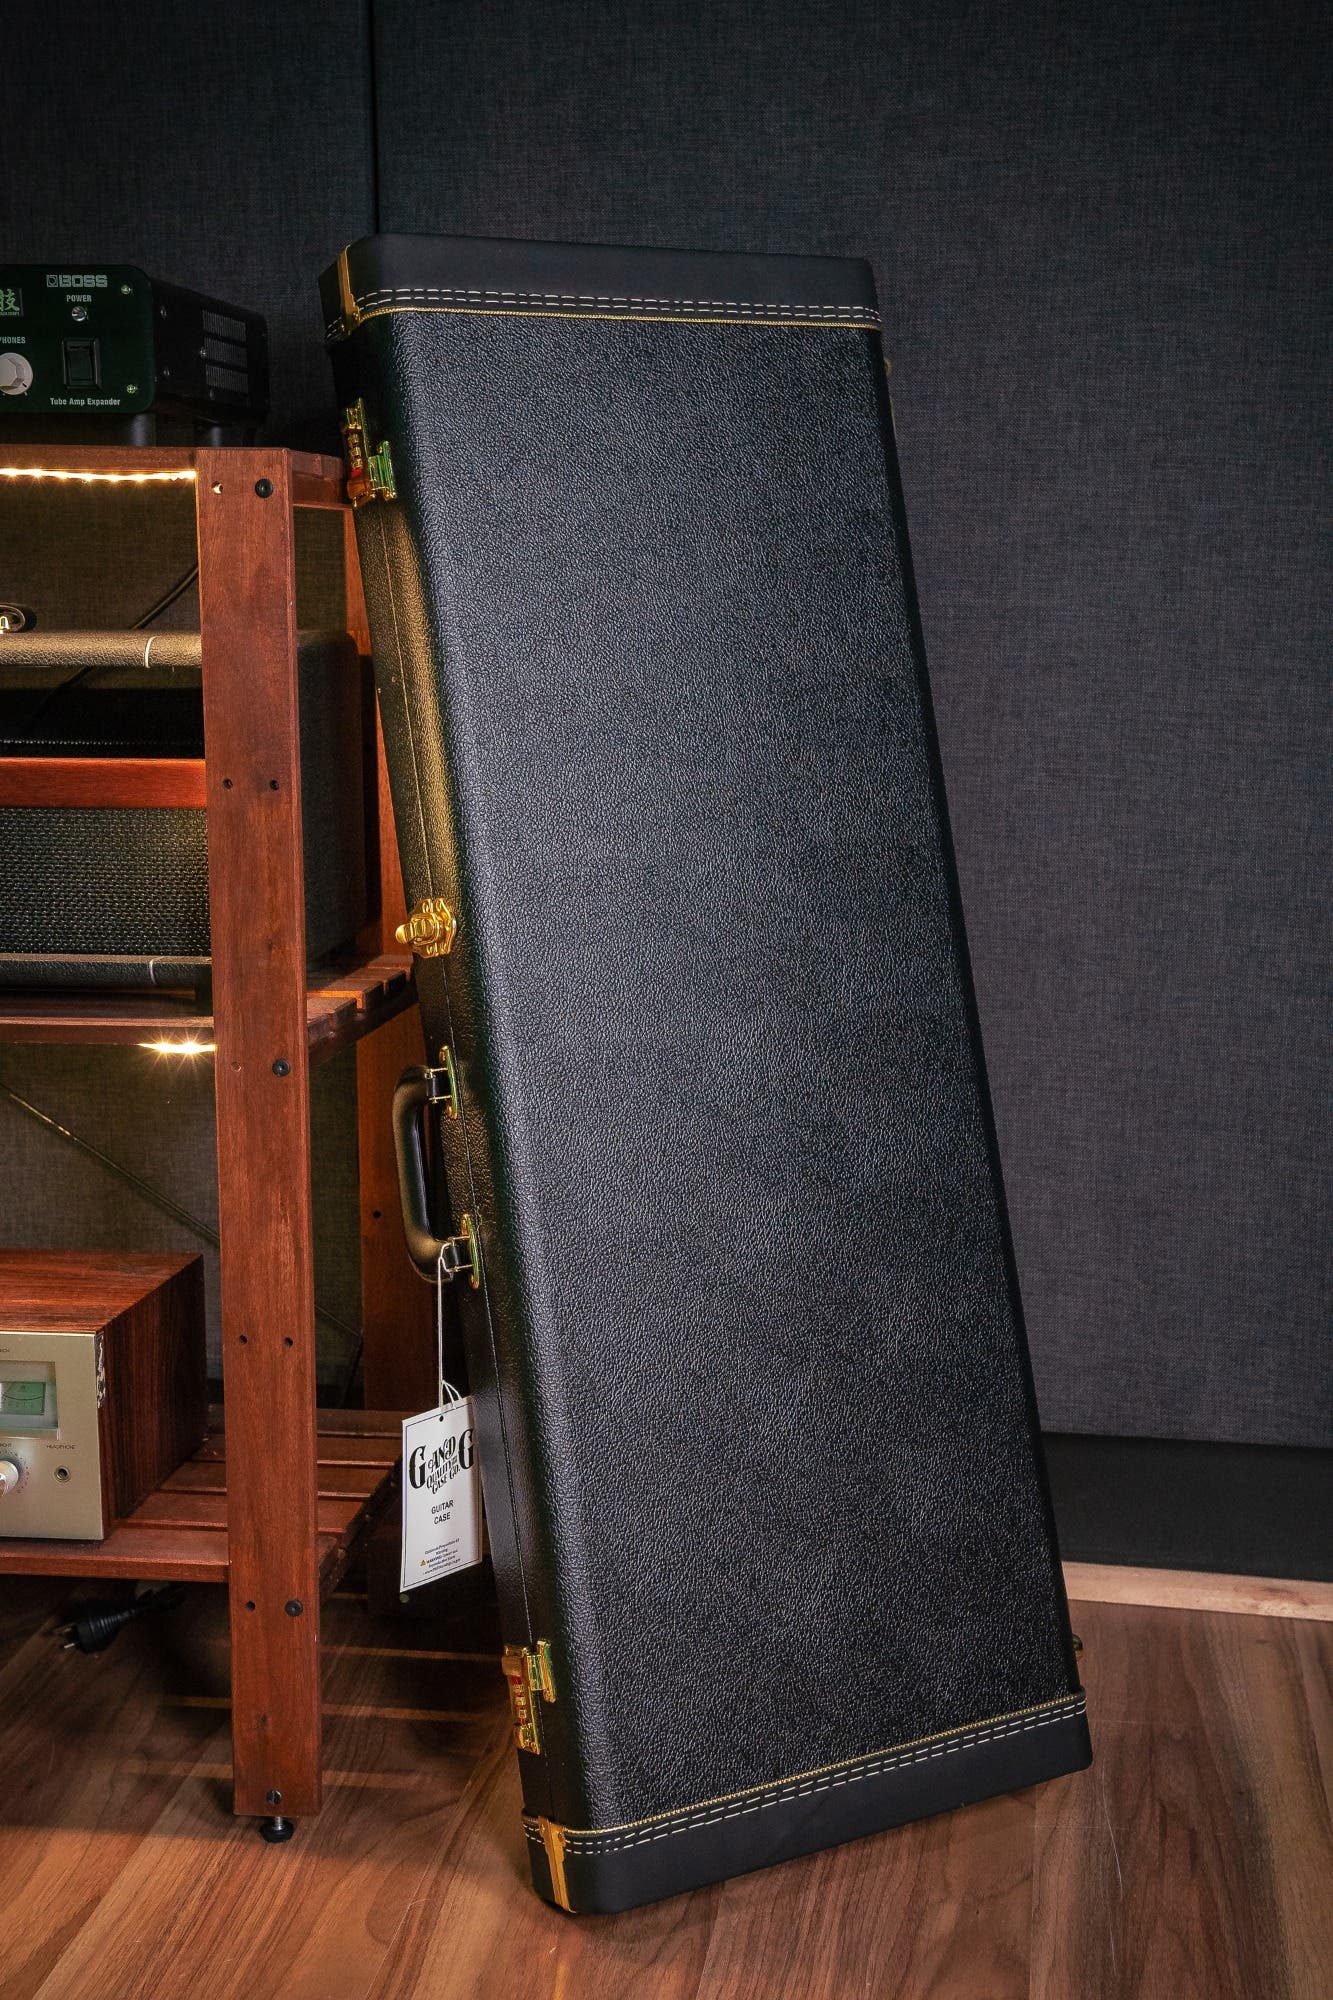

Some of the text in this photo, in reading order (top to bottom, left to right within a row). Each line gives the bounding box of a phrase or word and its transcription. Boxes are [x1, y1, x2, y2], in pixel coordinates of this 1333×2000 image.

[59, 275, 108, 287] BOSS
[66, 294, 92, 303] POWER
[50, 397, 121, 407] Tube Amp Expander
[409, 1445, 427, 1490] G
[431, 1499, 454, 1515] GUITAR
[433, 1511, 451, 1525] CASE
